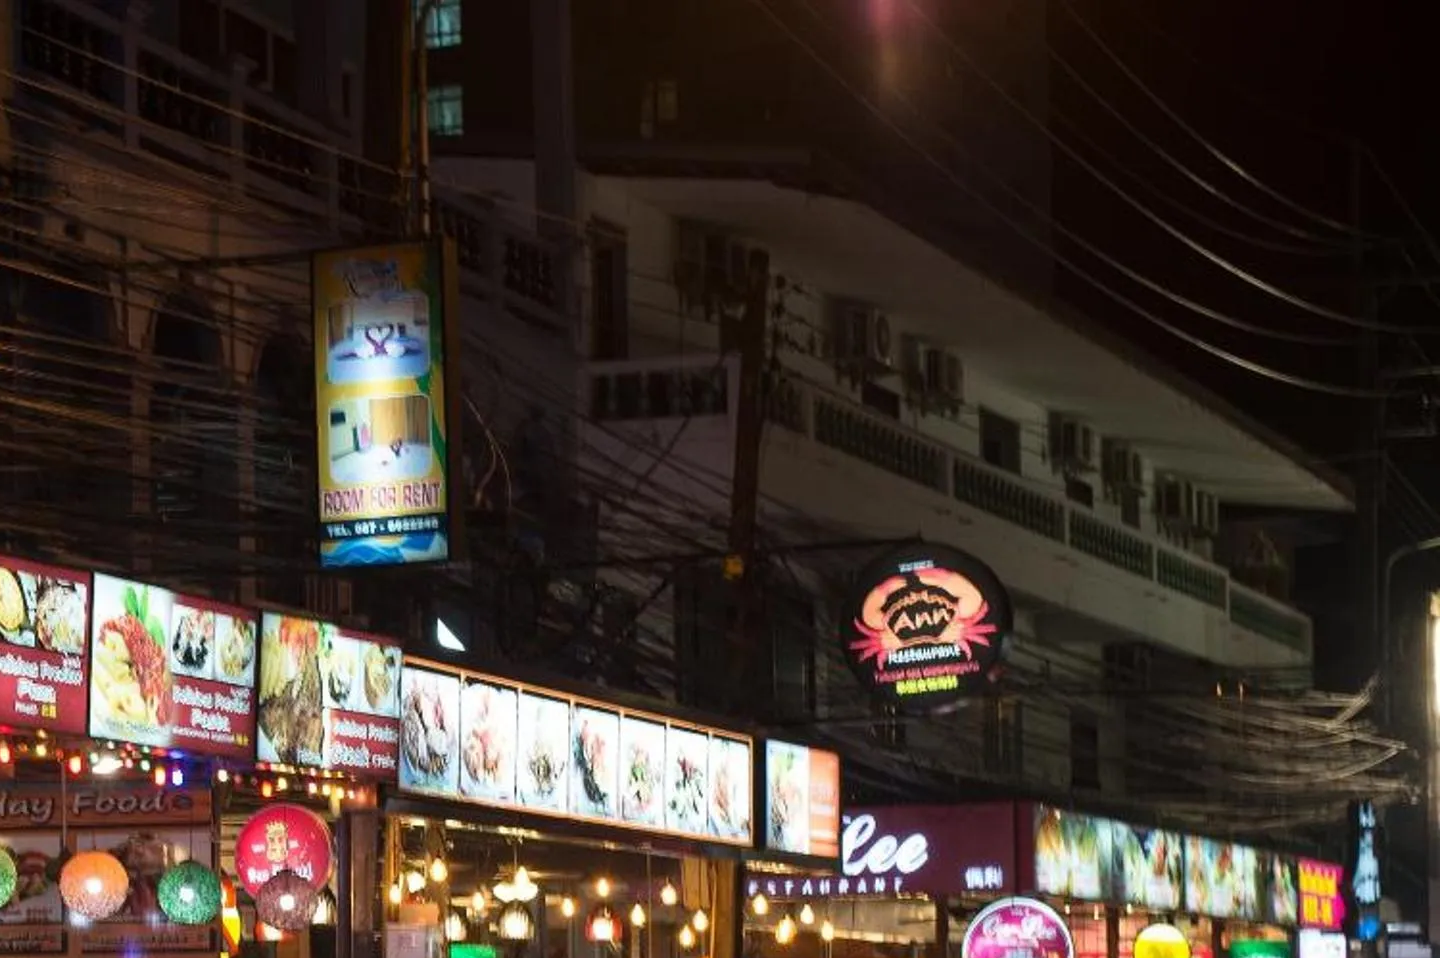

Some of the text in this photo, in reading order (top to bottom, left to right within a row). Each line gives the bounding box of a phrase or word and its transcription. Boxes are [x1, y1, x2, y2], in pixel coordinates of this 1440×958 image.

[324, 482, 440, 514] ROOM FOR RENT
[894, 607, 950, 634] Ann
